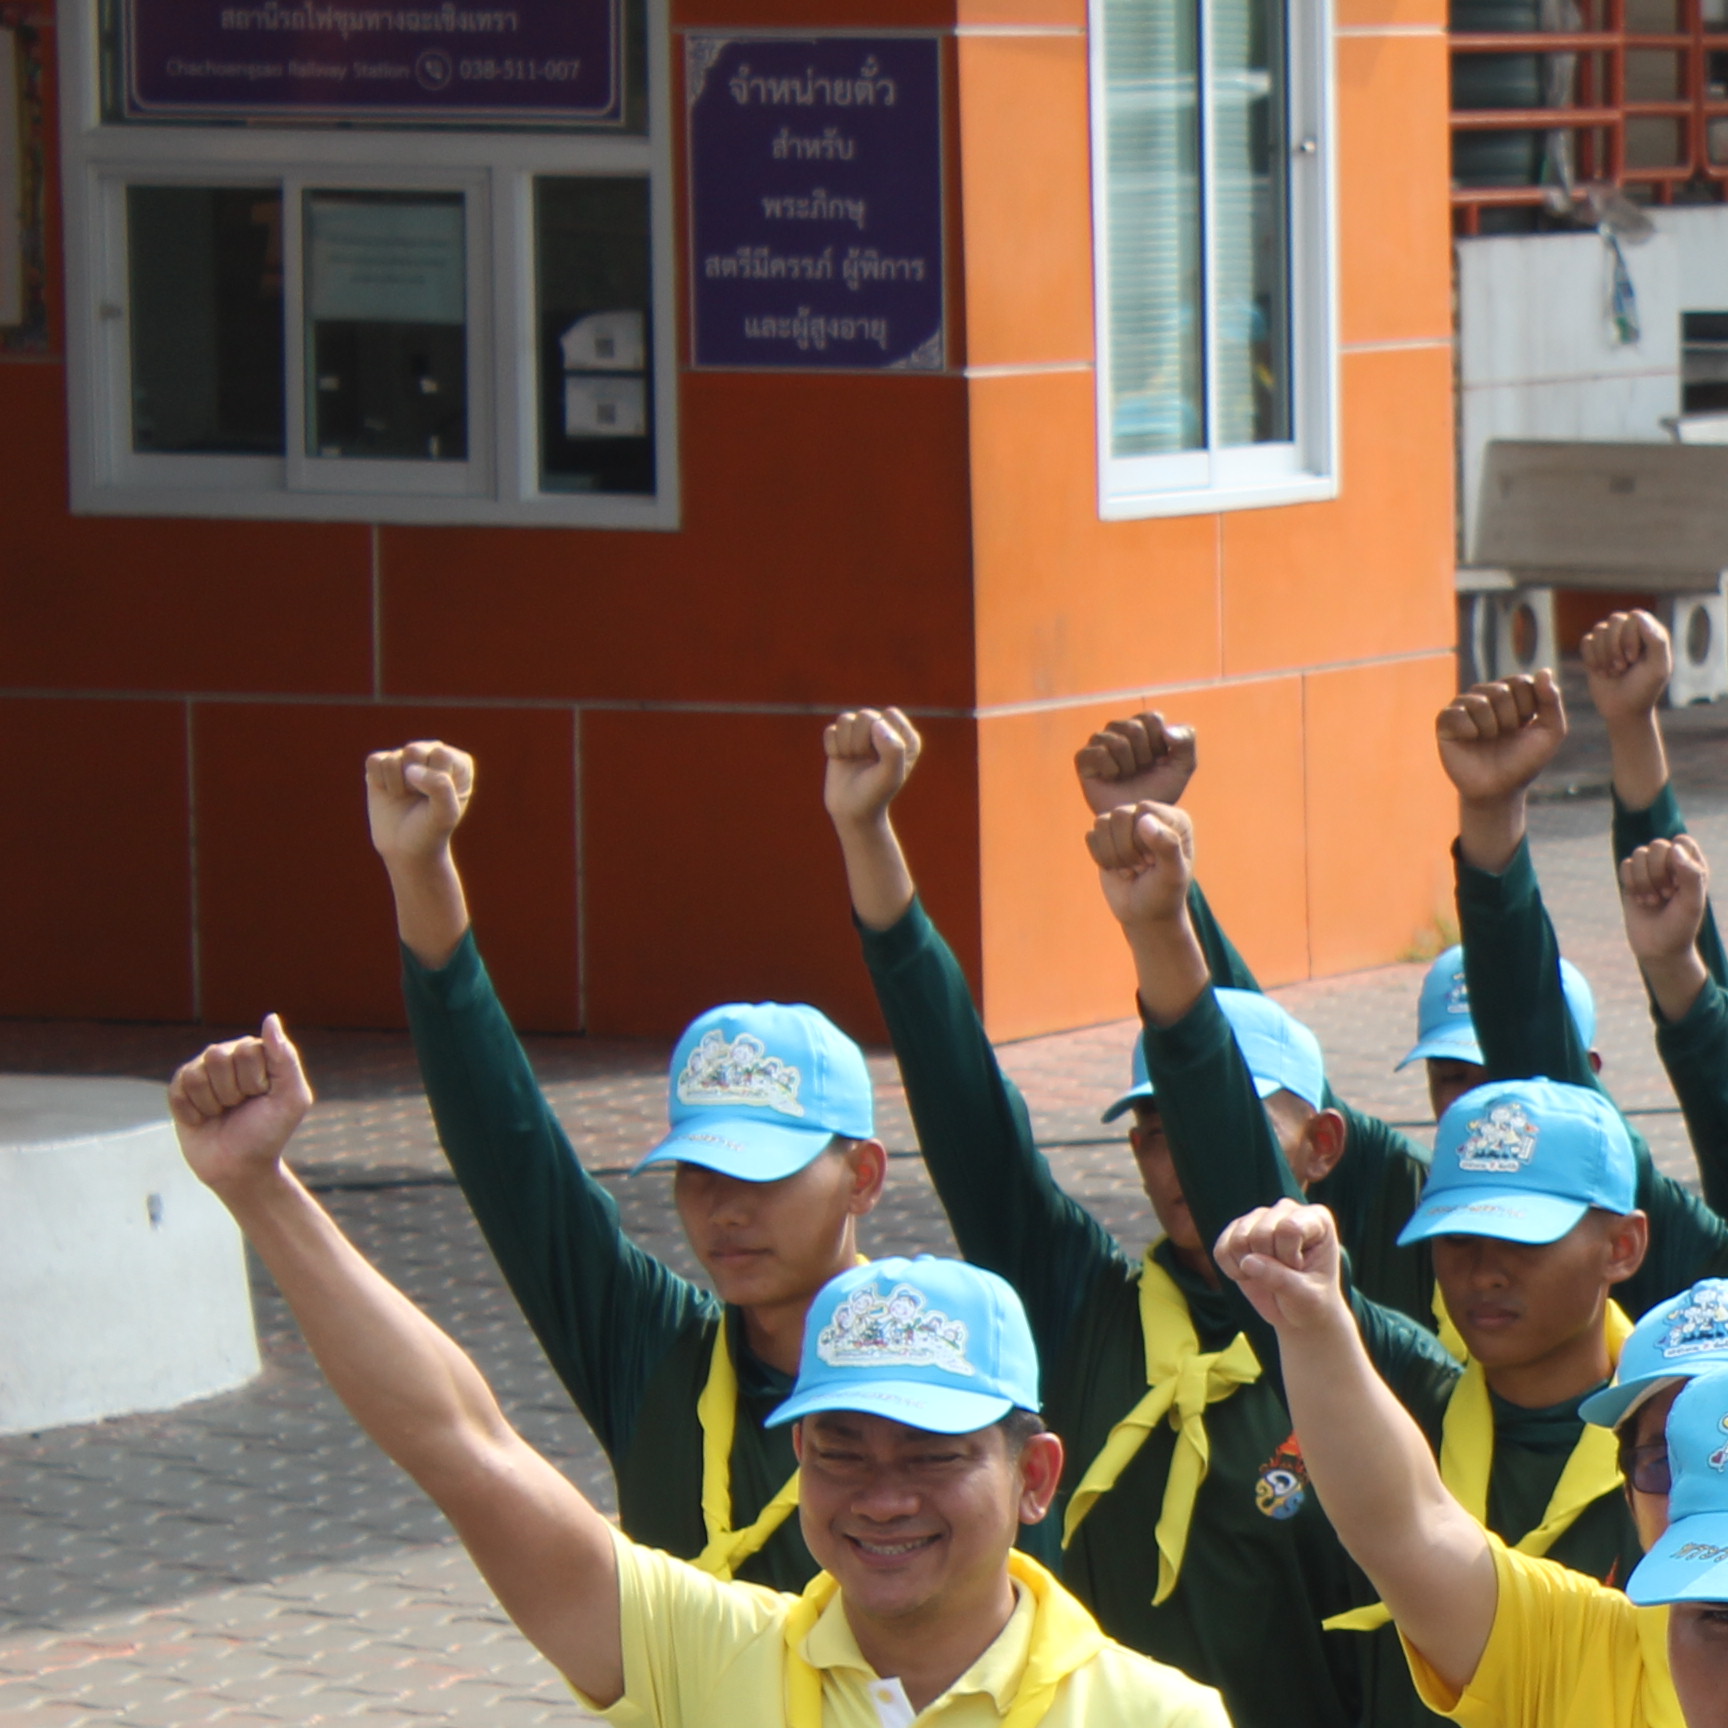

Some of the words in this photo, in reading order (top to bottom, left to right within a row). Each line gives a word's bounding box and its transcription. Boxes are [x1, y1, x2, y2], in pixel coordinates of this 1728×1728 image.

[353, 61, 410, 79] Station
[458, 58, 581, 81] 038-511-007
[729, 54, 896, 107] จำหน่ายตั๋ว
[771, 125, 855, 161] สำหรับ
[761, 187, 866, 231] พระภิกษุ
[841, 247, 926, 291] ผู้พิการ
